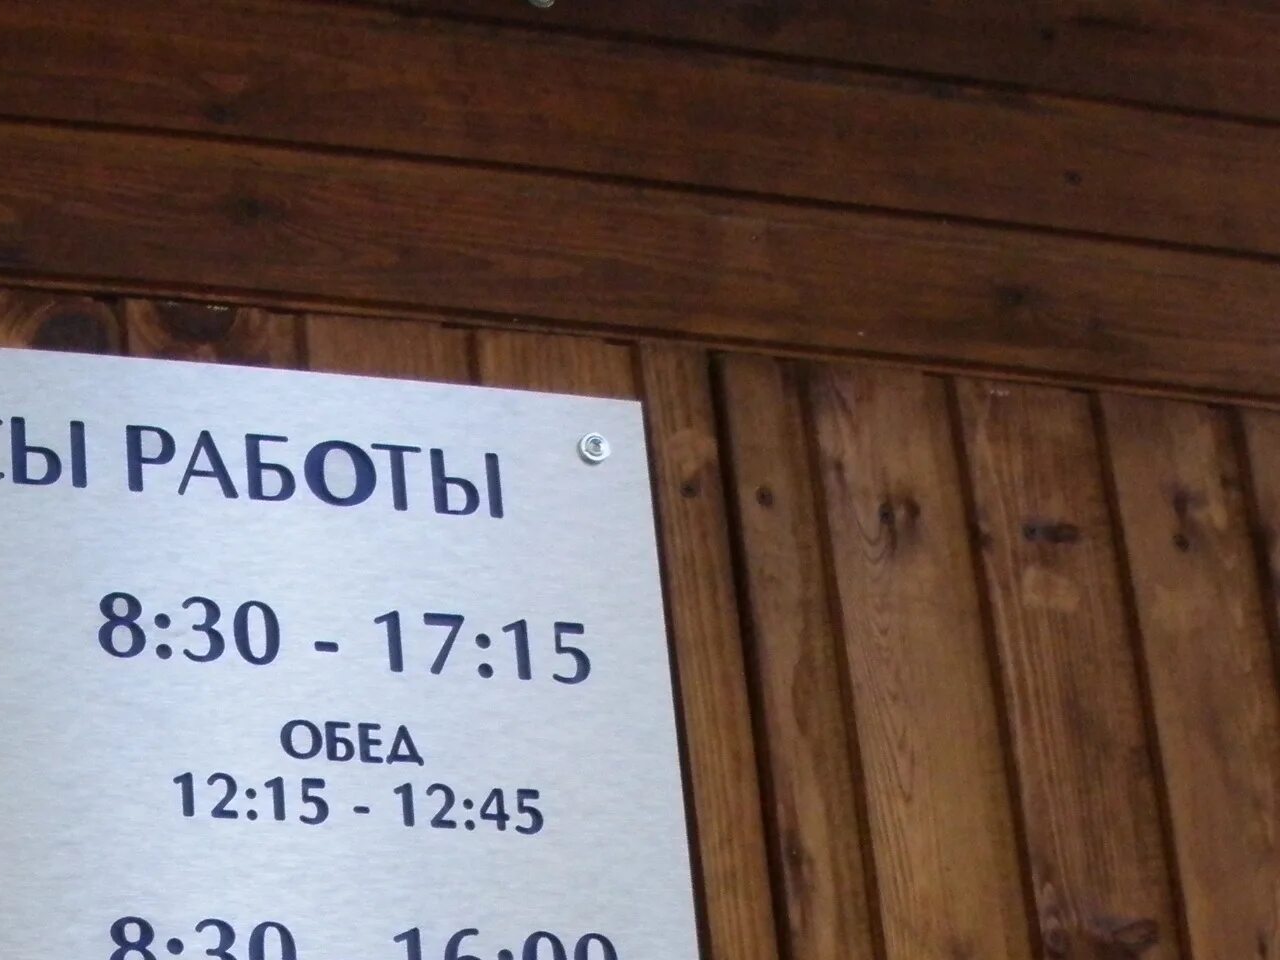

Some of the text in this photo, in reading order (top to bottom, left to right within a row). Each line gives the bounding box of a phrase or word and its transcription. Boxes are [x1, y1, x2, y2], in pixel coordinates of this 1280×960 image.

[125, 424, 506, 521] РАБОТЫ
[97, 591, 593, 686] 8:30 - 17:15
[279, 718, 426, 768] ОБЕД
[172, 771, 546, 836] 12:15 - 12:45
